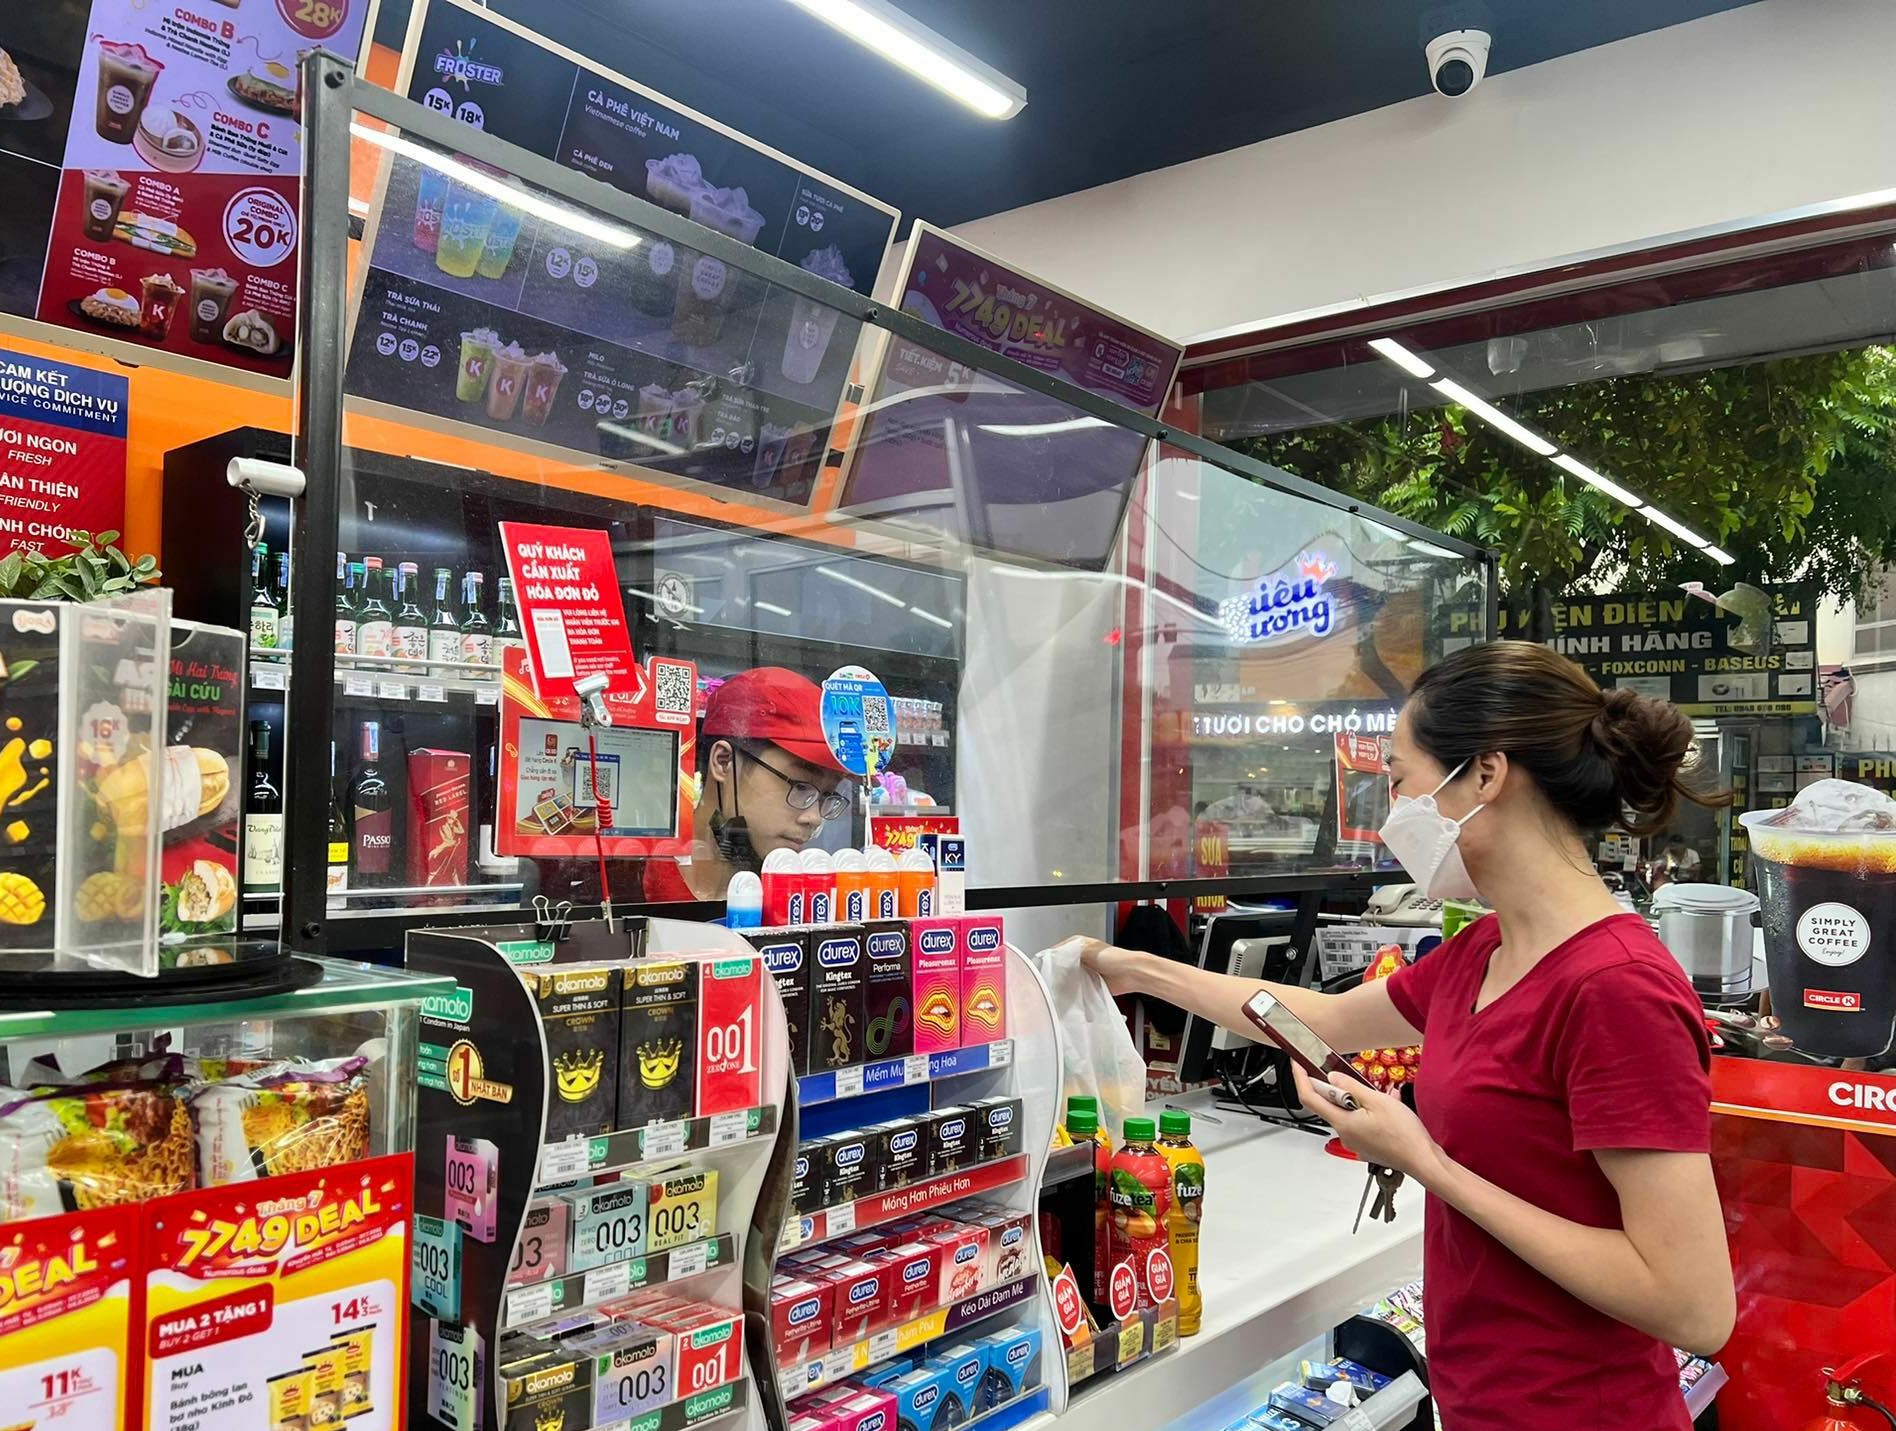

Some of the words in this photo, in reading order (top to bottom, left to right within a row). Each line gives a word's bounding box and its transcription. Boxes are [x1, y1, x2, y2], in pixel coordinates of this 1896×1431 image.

[174, 8, 217, 33] COMBO
[219, 20, 234, 40] B
[436, 56, 502, 85] FROSTER
[584, 103, 625, 130] Vietnamese
[624, 120, 648, 139] coffee
[587, 88, 605, 107] CÀ
[605, 98, 630, 118] PHÊ
[629, 106, 655, 130] VIỆT
[655, 120, 680, 142] NAM
[213, 111, 253, 133] COMBO
[256, 121, 270, 140] C
[139, 175, 169, 192] COMBO
[170, 184, 180, 196] A
[247, 197, 285, 215] ORIGINAL
[249, 206, 280, 221] COMBO
[73, 247, 108, 263] COMBO
[109, 257, 117, 267] B
[247, 274, 280, 291] COMBO
[280, 283, 289, 293] C
[152, 304, 164, 321] K
[36, 369, 69, 388] KẾT
[469, 361, 481, 376] K
[0, 376, 49, 399] ƯỢNG
[54, 388, 92, 406] DỊCH
[96, 397, 119, 414] VỤ
[500, 379, 513, 395] K
[33, 399, 118, 423] COMMITMENT
[26, 434, 77, 456] NGON
[7, 449, 53, 466] FRESH
[28, 478, 80, 500] THIỆN
[0, 494, 61, 513] FRIENDLY
[10, 538, 45, 553] FAST
[545, 543, 586, 562] KHÁCH
[521, 560, 550, 580] CẦN
[551, 561, 581, 581] XUẤT
[526, 583, 553, 600] HÓA
[553, 585, 581, 601] ĐƠN
[581, 581, 600, 602] ĐỎ
[1602, 598, 1684, 630] ĐIỆN
[1621, 629, 1714, 654] HÃNG
[1601, 659, 1686, 677] FOXCONN
[1704, 654, 1781, 672] BASEUS
[190, 681, 221, 701] CỨU
[1255, 714, 1305, 734] CHO
[1310, 708, 1362, 733] CHÓ
[944, 851, 962, 865] KY
[1811, 917, 1857, 928] SIMPLY
[1812, 927, 1855, 938] GREAT
[869, 935, 904, 954] durex
[922, 931, 953, 951] durex
[970, 930, 998, 949] durex
[1808, 936, 1859, 948] COFFEE
[764, 949, 799, 971] durex
[821, 942, 857, 963] durex
[966, 955, 1001, 967] Pleasuremax
[715, 964, 750, 978] okamoto
[872, 962, 902, 974] Performa
[918, 957, 957, 970] Pleasuremax
[555, 971, 607, 994] okamoto
[638, 966, 685, 986] okamoto
[825, 970, 853, 983] Kingtex
[552, 1003, 572, 1014] SUPER
[1808, 993, 1842, 1005] CIRCLE
[1842, 995, 1856, 1007] K
[423, 1015, 447, 1029] Condom
[565, 1015, 596, 1027] CROWN
[647, 1006, 675, 1018] CROWN
[865, 1068, 887, 1083] Mềm
[990, 1109, 1012, 1126] durex
[941, 1121, 965, 1139] durex
[892, 1134, 916, 1152] durex
[838, 1146, 864, 1166] durex
[665, 1179, 704, 1197] okamoto
[881, 1194, 909, 1213] Mỏng
[909, 1189, 928, 1205] Hơn
[928, 1181, 953, 1199] Phiêu
[953, 1177, 971, 1193] Hơn
[1109, 1186, 1155, 1207] fuzetea
[256, 1194, 306, 1220] Tháng
[307, 1188, 325, 1211] 7
[592, 1193, 632, 1214] okamoto
[174, 1212, 292, 1271] 7749
[294, 1187, 382, 1247] DEAL
[1002, 1228, 1022, 1246] durex
[956, 1245, 979, 1264] durex
[203, 1266, 245, 1279] Numerous
[905, 1260, 930, 1280] durex
[851, 1280, 877, 1300] durex
[960, 1301, 978, 1317] Kéo
[977, 1294, 993, 1311] Dài
[992, 1289, 1011, 1306] Đam
[1010, 1283, 1024, 1298] Mê
[159, 1317, 197, 1338] MUA
[200, 1313, 211, 1327] 2
[213, 1303, 257, 1324] TẶNG
[258, 1299, 267, 1313] 1
[790, 1300, 819, 1322] durex
[158, 1336, 182, 1350] BUY
[183, 1334, 190, 1344] 2
[191, 1328, 213, 1341] GET
[692, 1326, 731, 1347] okamoto
[614, 1345, 656, 1368] okamoto
[1007, 1342, 1030, 1361] durex
[171, 1363, 204, 1381] MUA
[958, 1362, 979, 1381] durex
[170, 1382, 189, 1392] Buy
[526, 1370, 574, 1394] okamoto
[170, 1395, 198, 1411] Bánh
[201, 1387, 229, 1403] bông
[232, 1382, 248, 1393] lan
[187, 1407, 208, 1419] nho
[211, 1399, 235, 1412] Kinh
[238, 1391, 253, 1404] Đô
[686, 1391, 731, 1417] okamoto
[914, 1387, 938, 1407] durex
